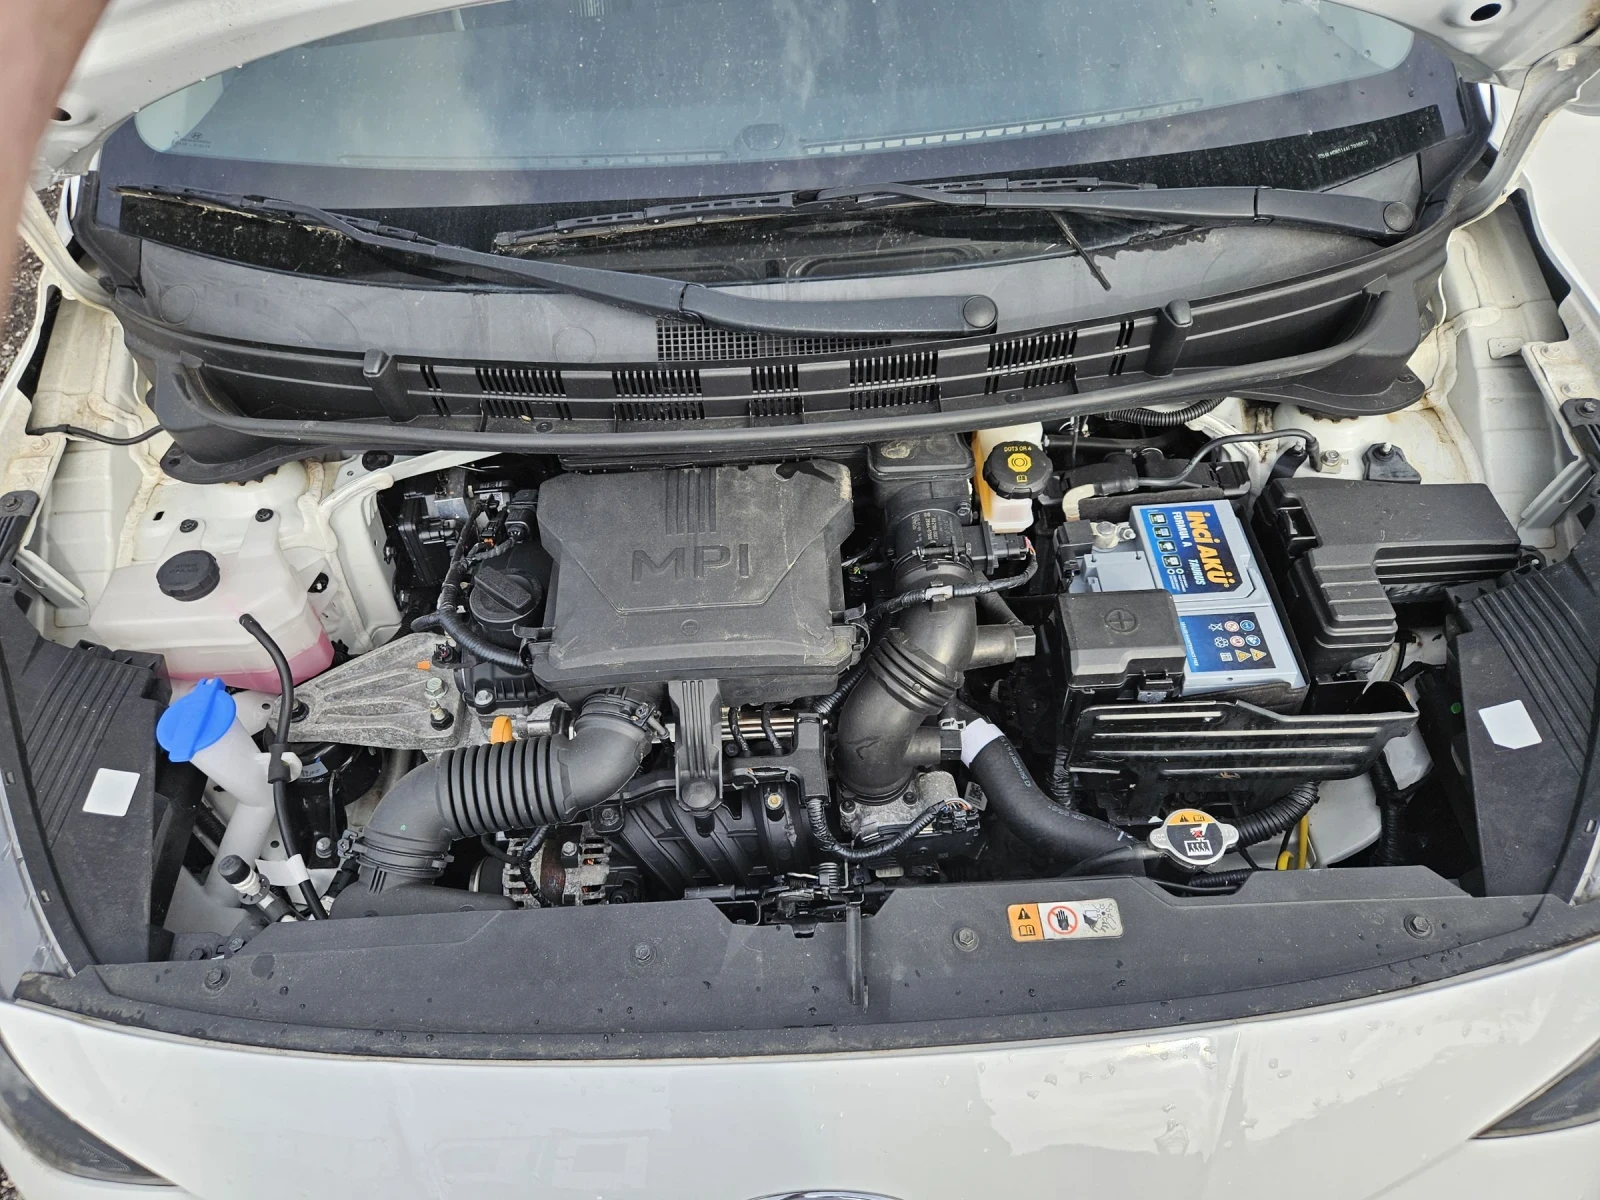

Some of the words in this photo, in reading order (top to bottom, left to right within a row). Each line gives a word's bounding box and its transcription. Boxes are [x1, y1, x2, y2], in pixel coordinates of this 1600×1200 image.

[631, 543, 750, 583] MPI
[1171, 511, 1191, 540] FORMUL
[1188, 558, 1207, 586] TAURUS
[1196, 544, 1236, 584] AKÜ
